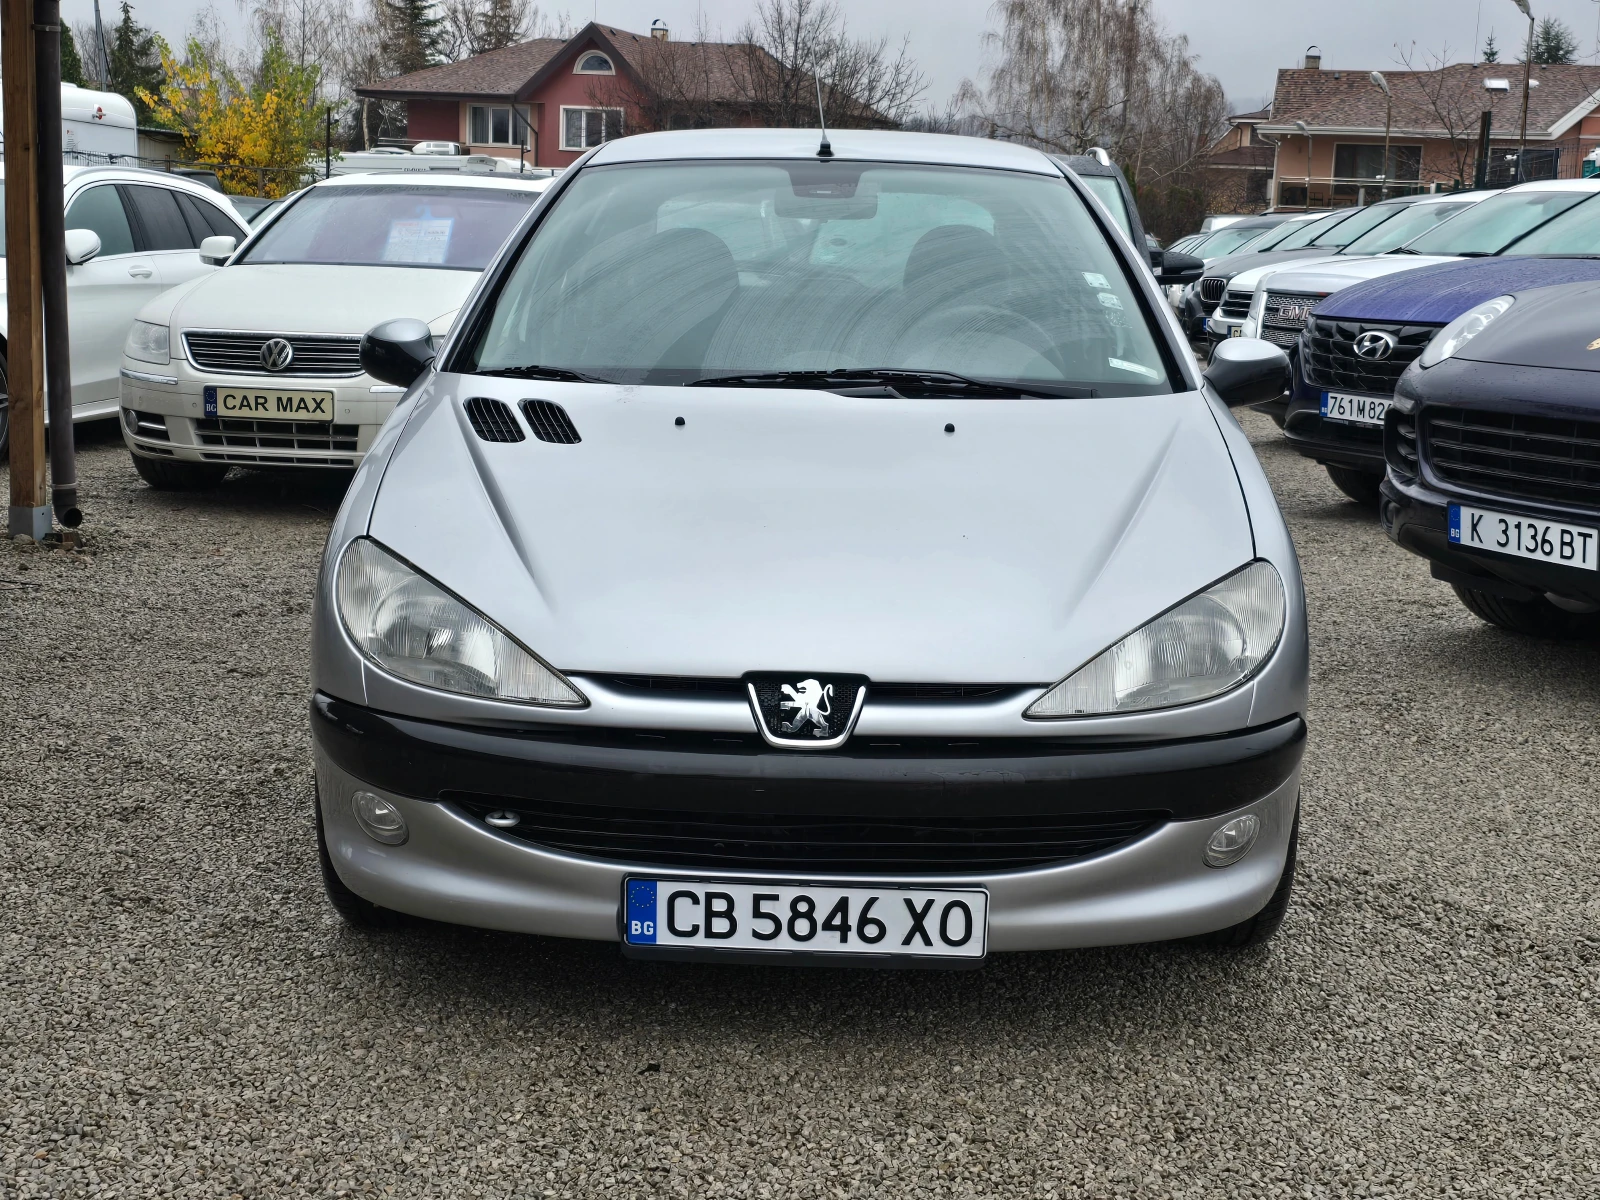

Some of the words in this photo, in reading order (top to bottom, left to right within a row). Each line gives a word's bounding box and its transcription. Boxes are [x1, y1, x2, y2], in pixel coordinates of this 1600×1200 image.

[206, 403, 217, 412] BG
[223, 394, 269, 411] CAR
[276, 397, 326, 413] MAX
[1329, 396, 1392, 420] 761M82
[1470, 512, 1484, 544] K
[631, 920, 654, 936] BG
[667, 889, 738, 939] CB
[752, 893, 887, 944] 5846
[901, 897, 973, 947] XO
